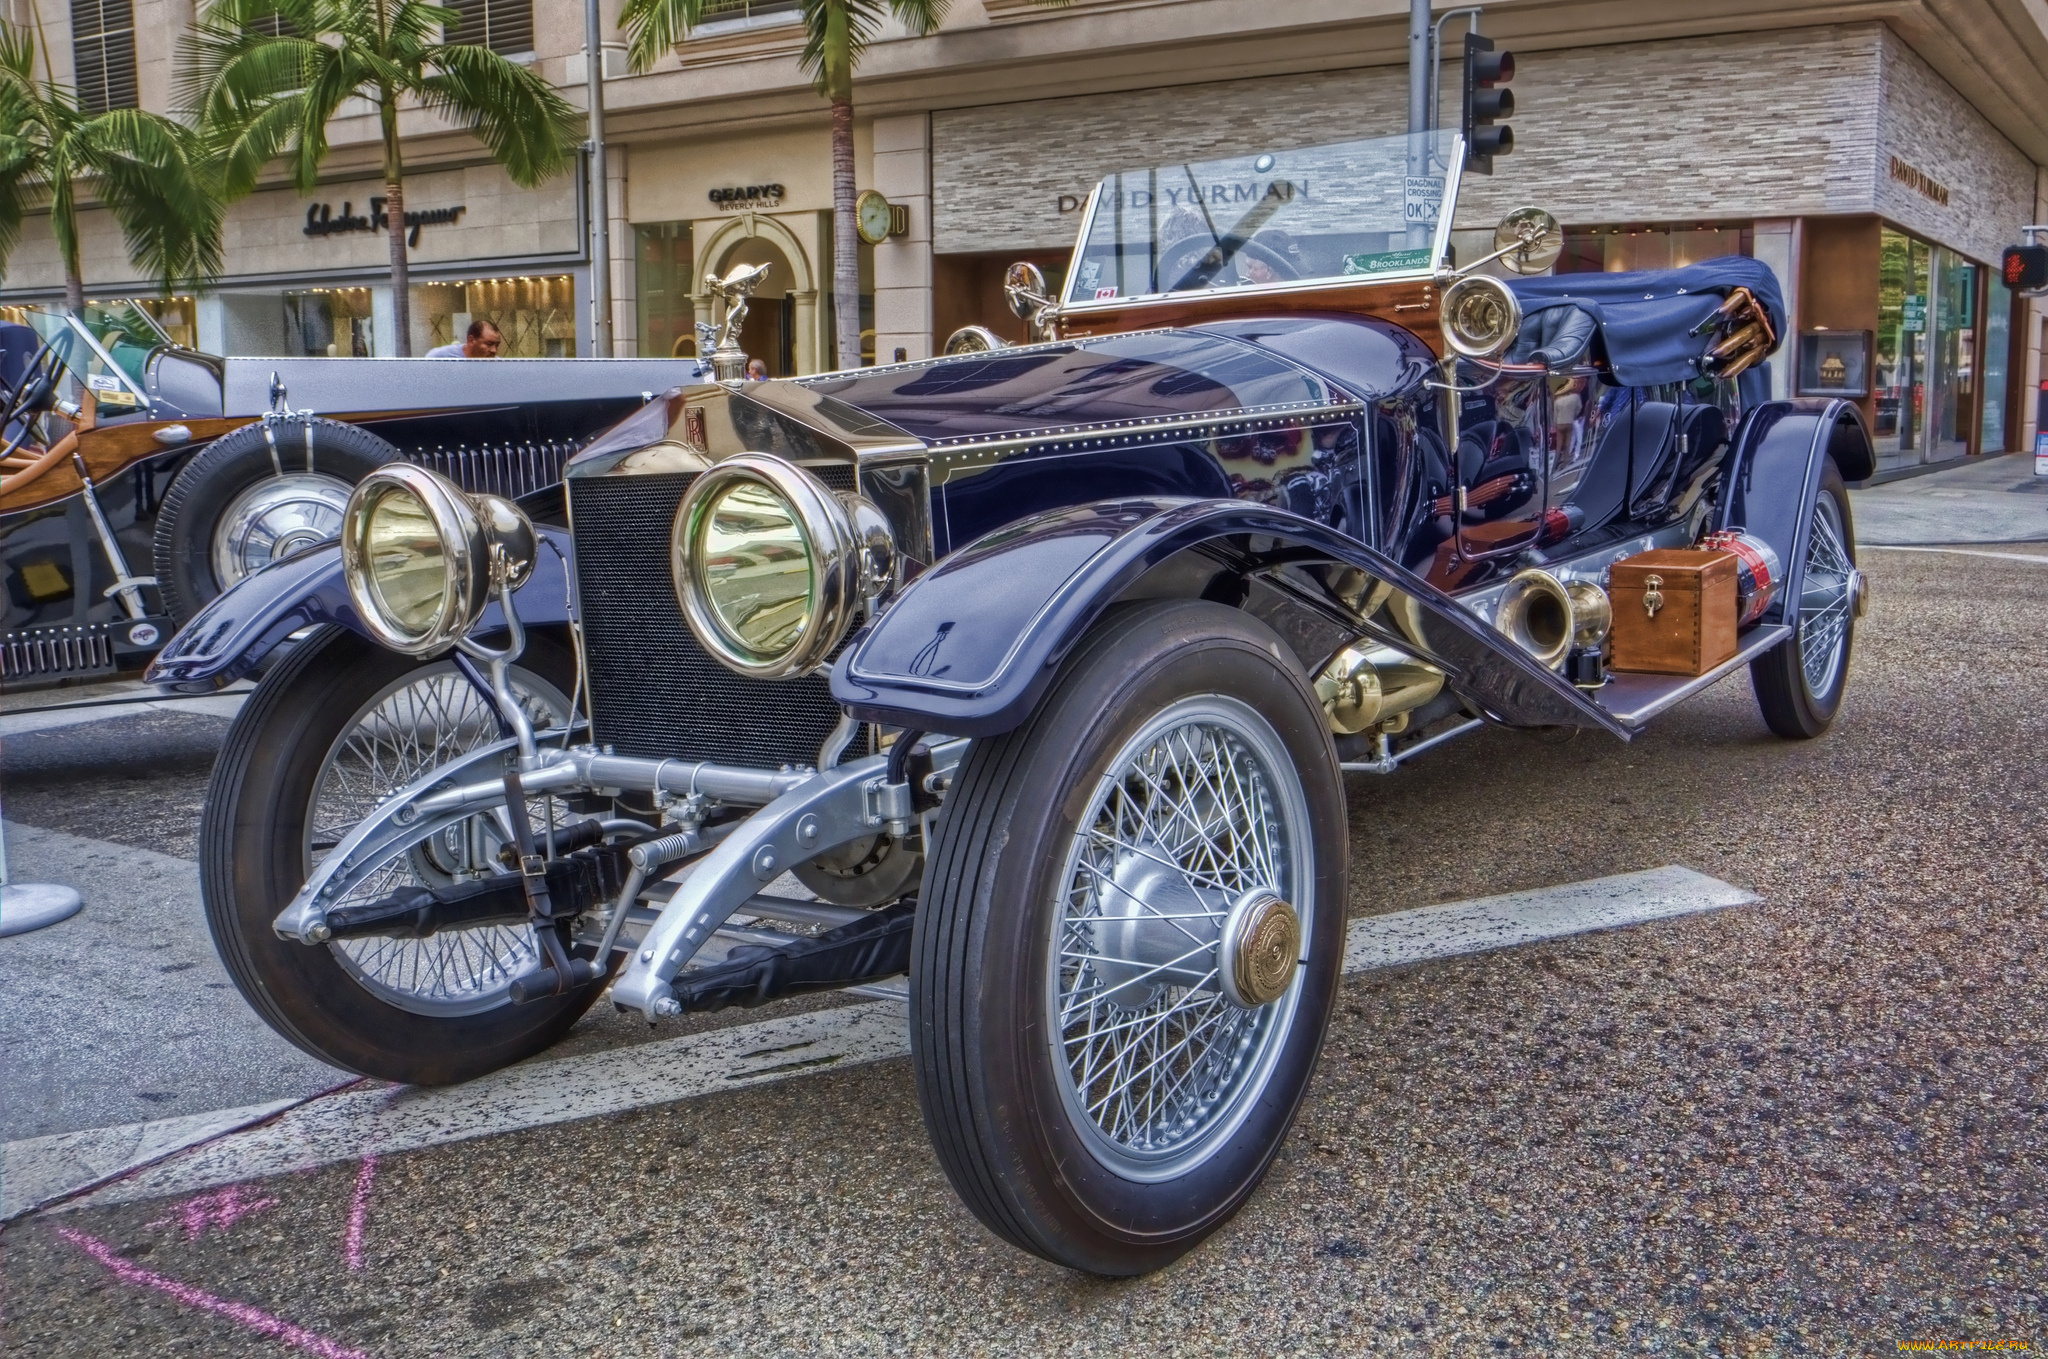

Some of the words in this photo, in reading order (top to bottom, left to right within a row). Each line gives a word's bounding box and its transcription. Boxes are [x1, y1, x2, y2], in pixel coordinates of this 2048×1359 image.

[1407, 179, 1442, 188] DIAGONAL
[708, 183, 785, 202] GEARYS
[1165, 180, 1309, 206] YURMAN
[1407, 189, 1442, 197] CROSSING
[719, 202, 754, 211] BEVERLY
[756, 200, 780, 208] HILLS
[1407, 203, 1423, 218] OK
[1370, 256, 1431, 269] BROOKLANDS
